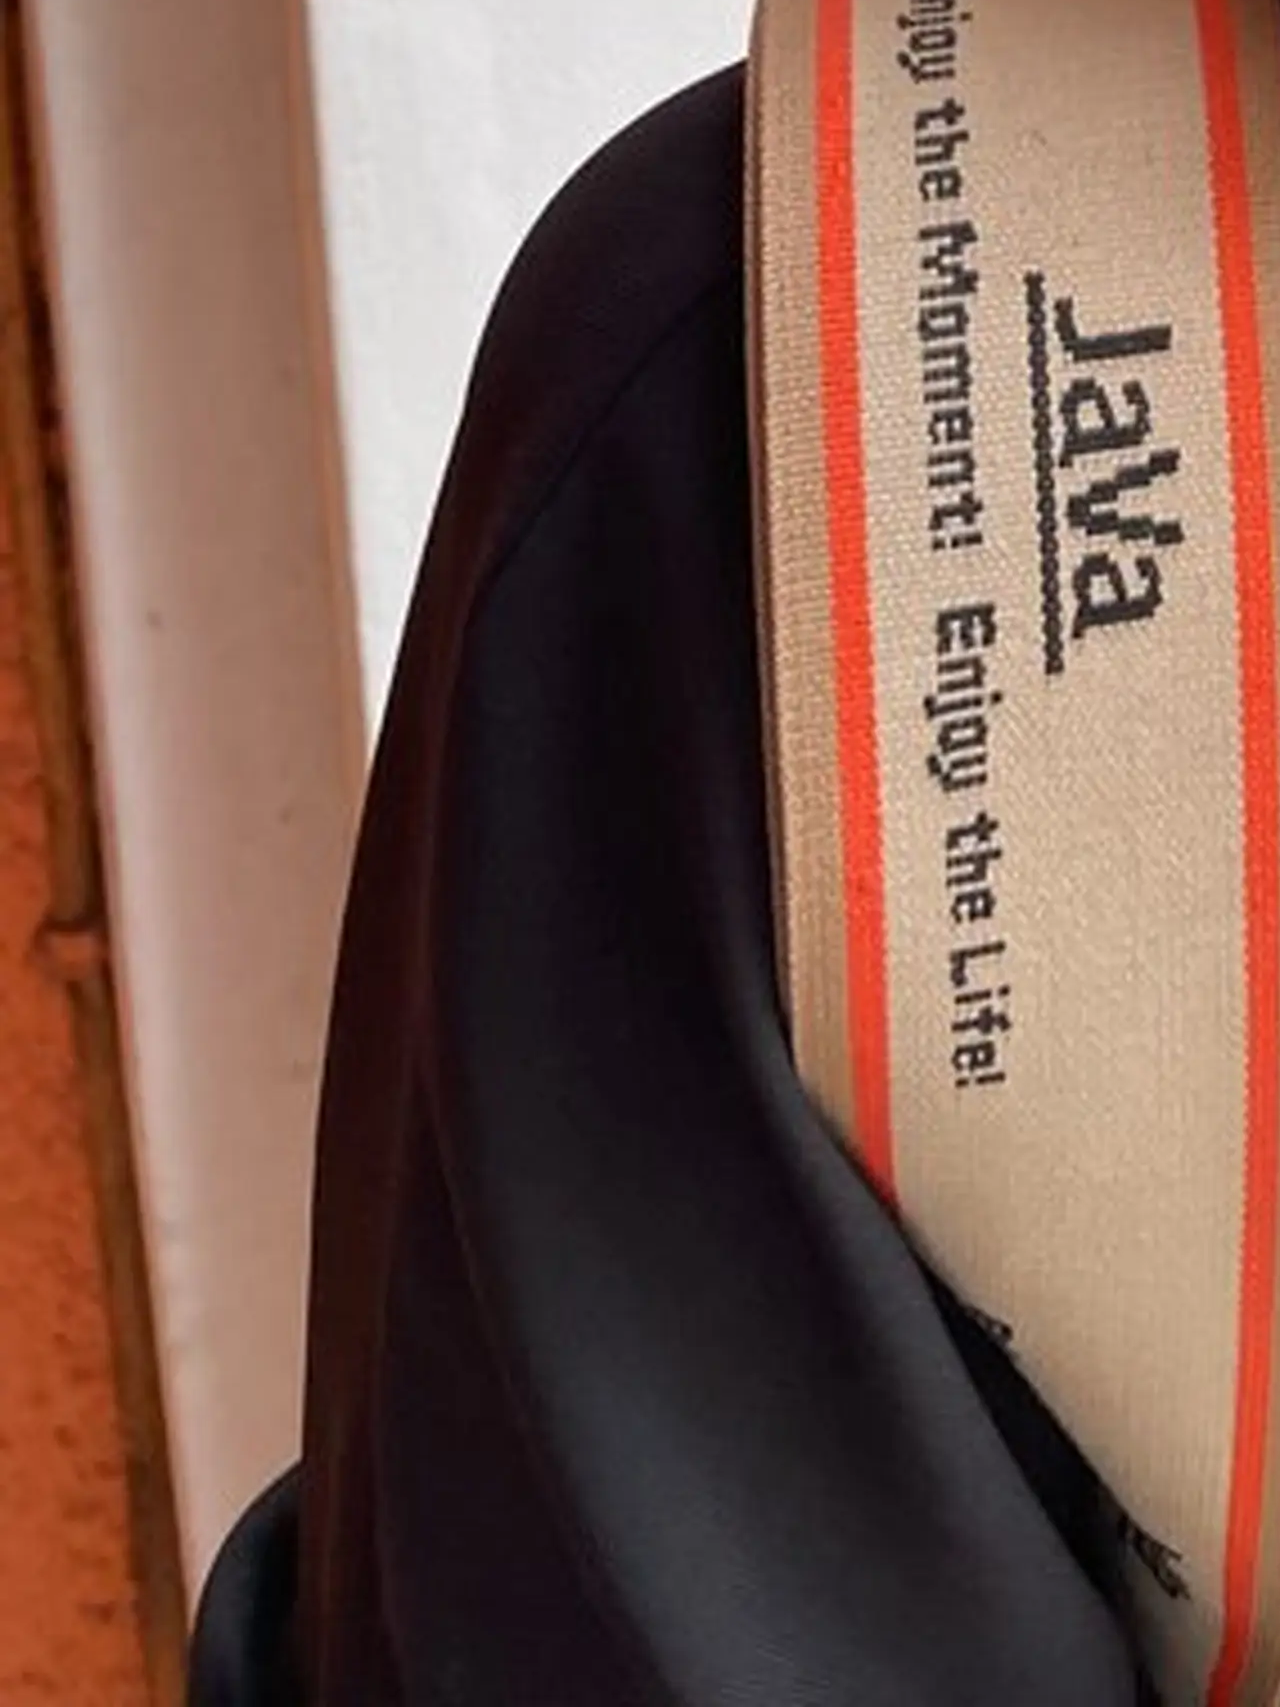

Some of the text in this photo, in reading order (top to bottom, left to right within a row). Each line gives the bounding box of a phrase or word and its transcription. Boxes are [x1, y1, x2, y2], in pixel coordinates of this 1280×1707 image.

[912, 97, 970, 203] the
[916, 220, 983, 552] Moment!
[923, 603, 1003, 794] Enjoy
[945, 812, 1003, 924] the
[948, 940, 1011, 1089] Life!
